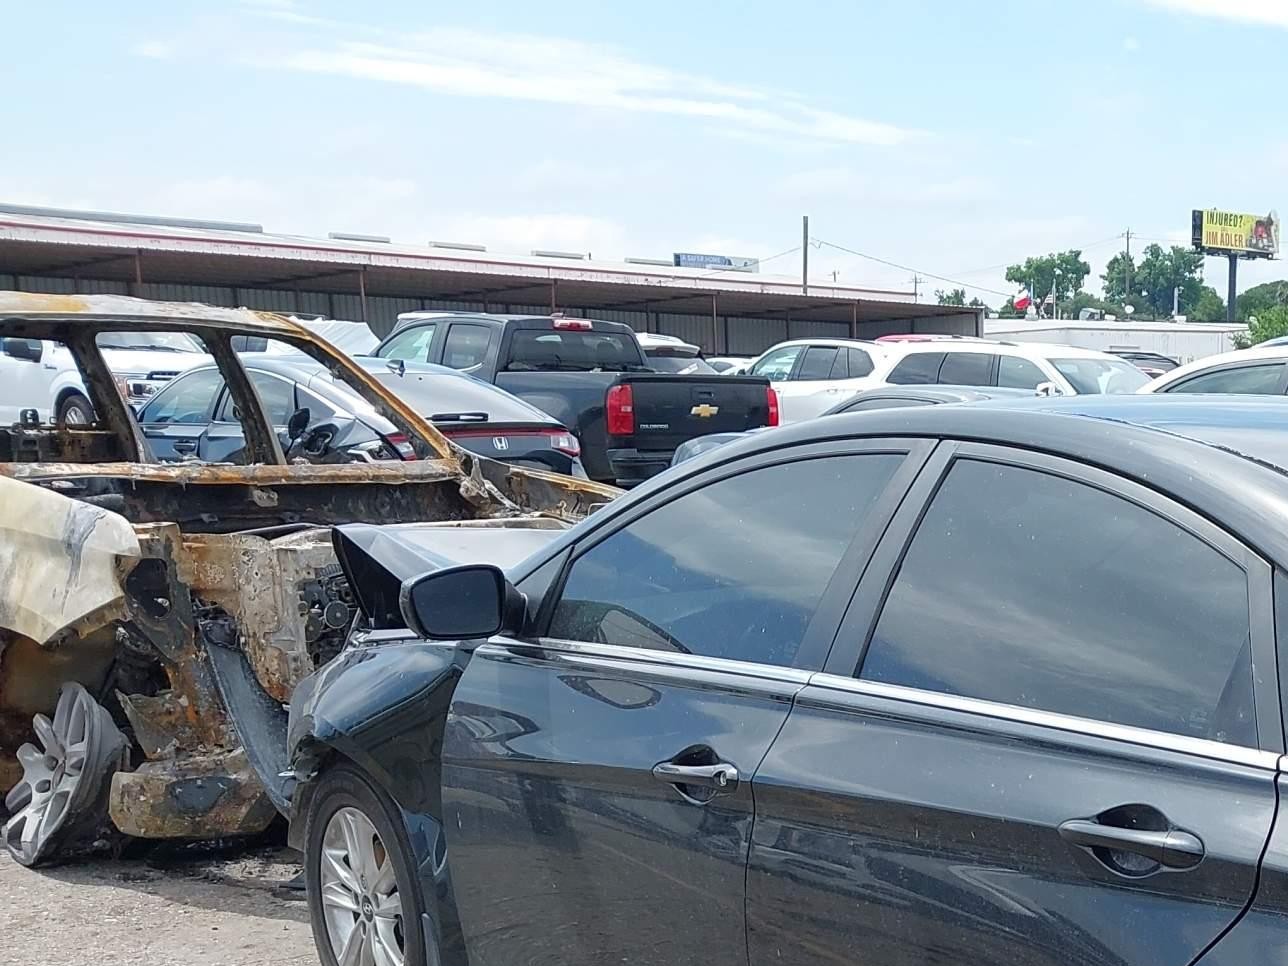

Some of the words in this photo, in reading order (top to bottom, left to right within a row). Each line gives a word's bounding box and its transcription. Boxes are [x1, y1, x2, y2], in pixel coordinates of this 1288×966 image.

[1206, 210, 1243, 228] INJURED?
[1205, 230, 1219, 246] JIM
[1221, 231, 1244, 248] ADLER
